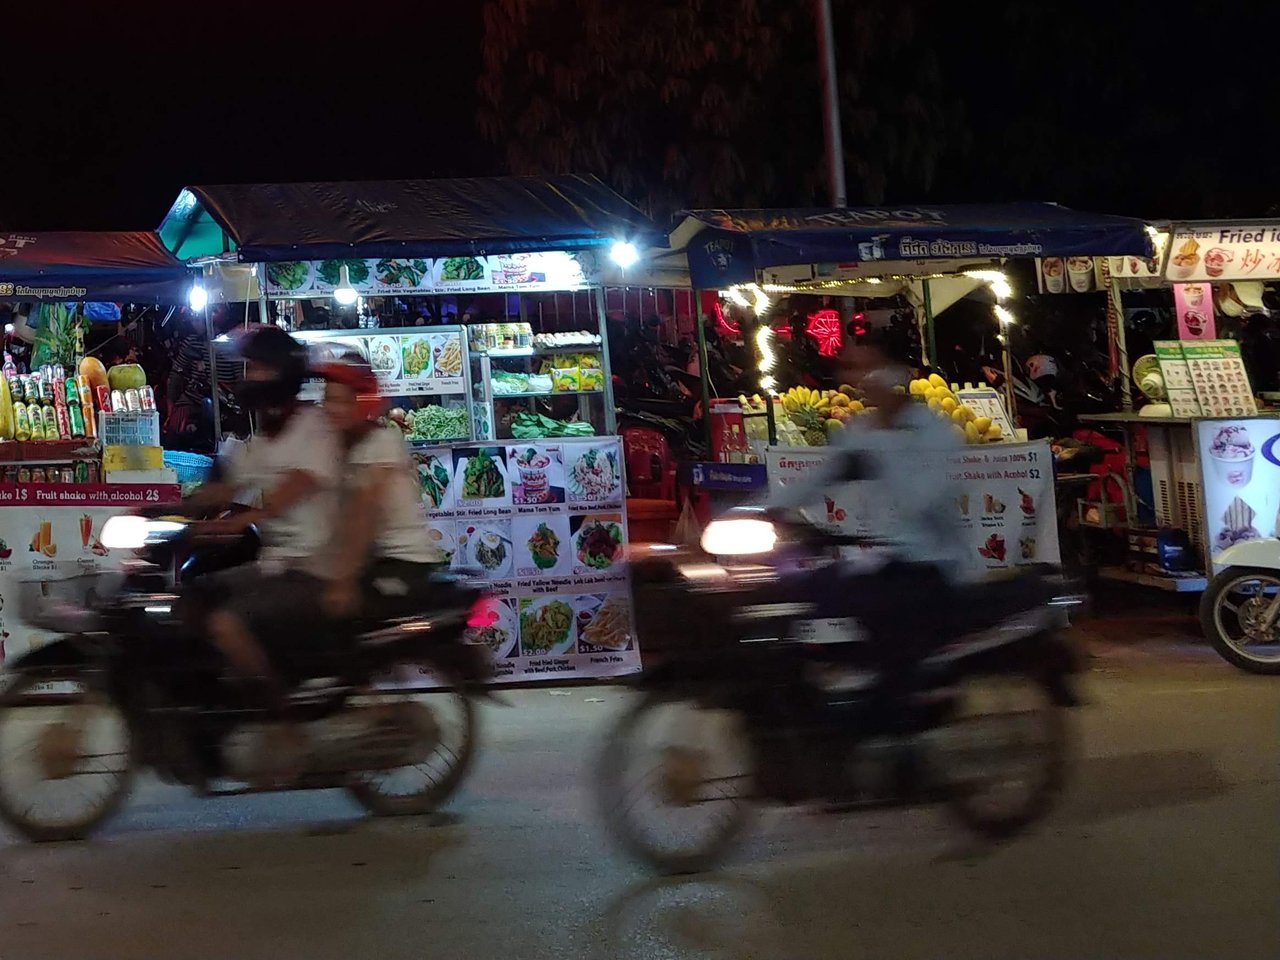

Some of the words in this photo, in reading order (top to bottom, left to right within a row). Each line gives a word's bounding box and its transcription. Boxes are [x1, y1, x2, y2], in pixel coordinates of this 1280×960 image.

[1218, 228, 1266, 244] Fried
[1028, 452, 1037, 462] $1
[1028, 469, 1041, 479] $2
[15, 488, 28, 500] 1$
[36, 491, 58, 500] Fruit
[60, 490, 87, 500] shake
[89, 490, 108, 500] with
[111, 490, 144, 500] alcohol
[145, 490, 160, 501] 2$
[424, 510, 455, 519] egetables
[579, 644, 604, 652] $1.50
